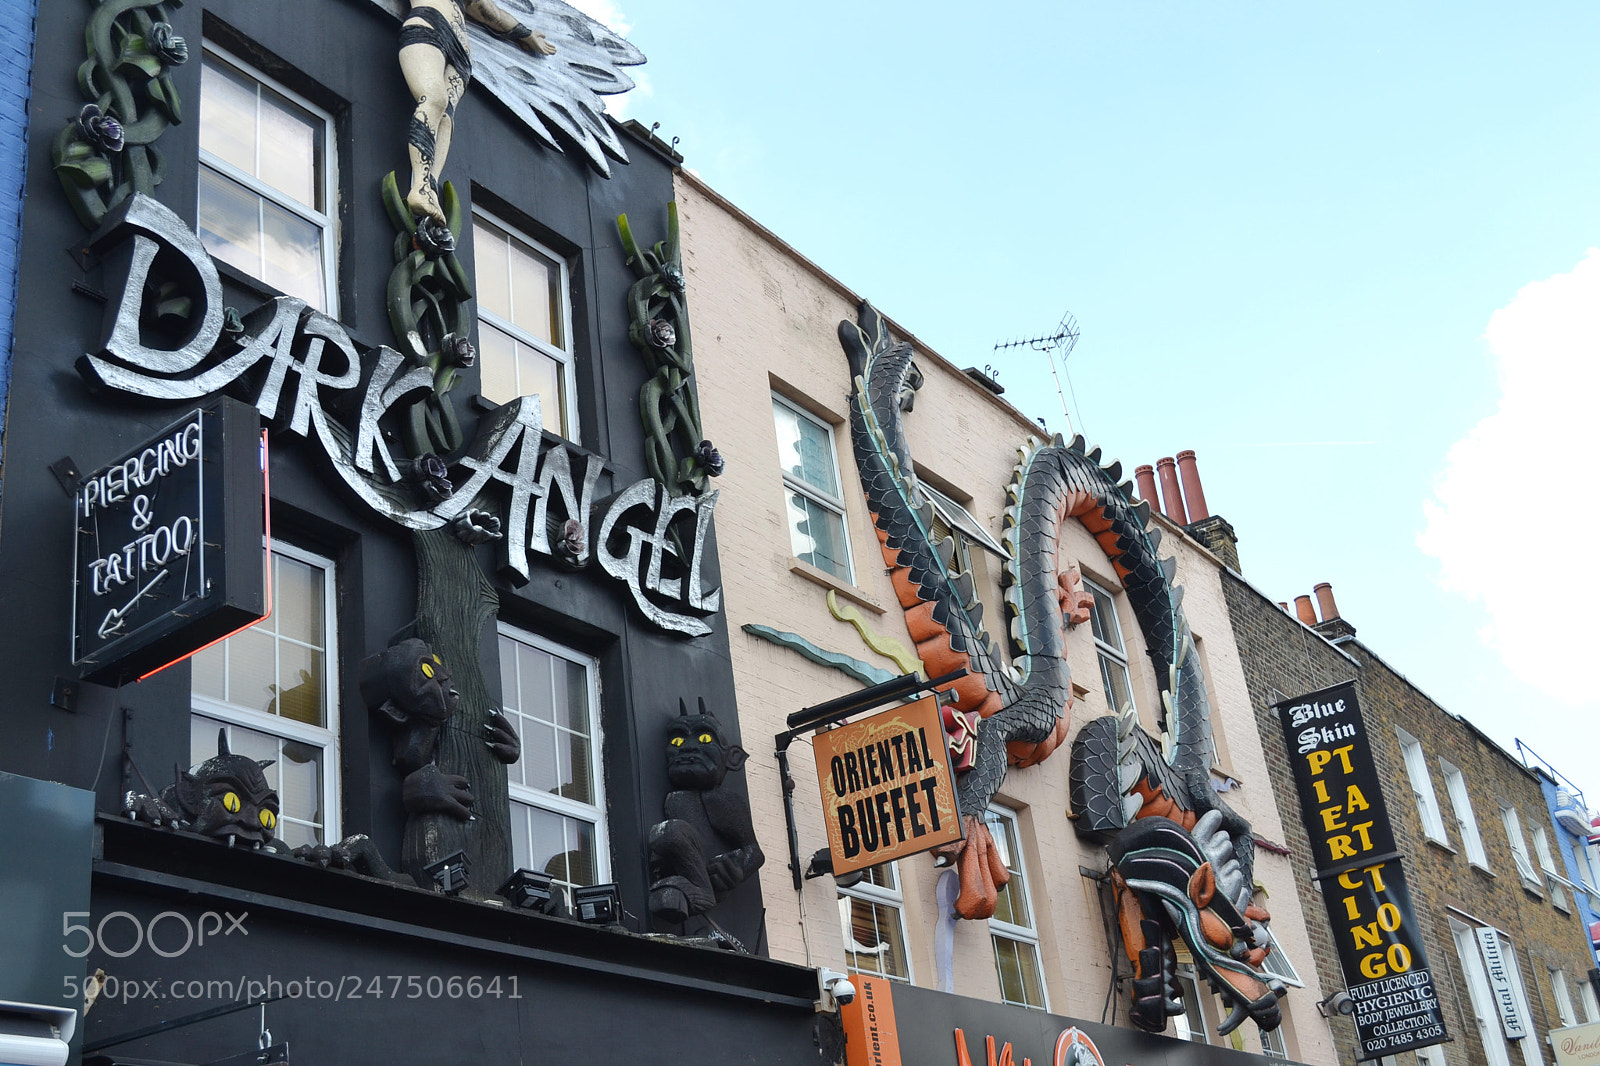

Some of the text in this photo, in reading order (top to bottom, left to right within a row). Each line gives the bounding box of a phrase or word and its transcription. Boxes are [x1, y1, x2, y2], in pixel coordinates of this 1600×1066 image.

[75, 192, 720, 636] DARK ANGEL
[84, 422, 200, 518] PIERCING
[131, 494, 153, 531] &
[89, 516, 192, 596] TATTOO
[1288, 699, 1346, 728] Blue
[1298, 722, 1356, 754] Skin
[830, 727, 934, 797] ORIENTAL
[837, 776, 941, 859] BUFFET
[1306, 750, 1388, 979] PIERCING
[1332, 744, 1411, 973] TATTOO
[1350, 971, 1429, 1000] FULLY LICENCED
[1355, 985, 1433, 1014] HYGIENIC
[1357, 998, 1437, 1026] BODY JEWELLERY
[1484, 933, 1522, 1031] Metal Militia
[864, 982, 882, 1066] rient.co.uk
[1366, 1025, 1442, 1051] 020 7485 4305
[1373, 1013, 1432, 1036] COLLECTION
